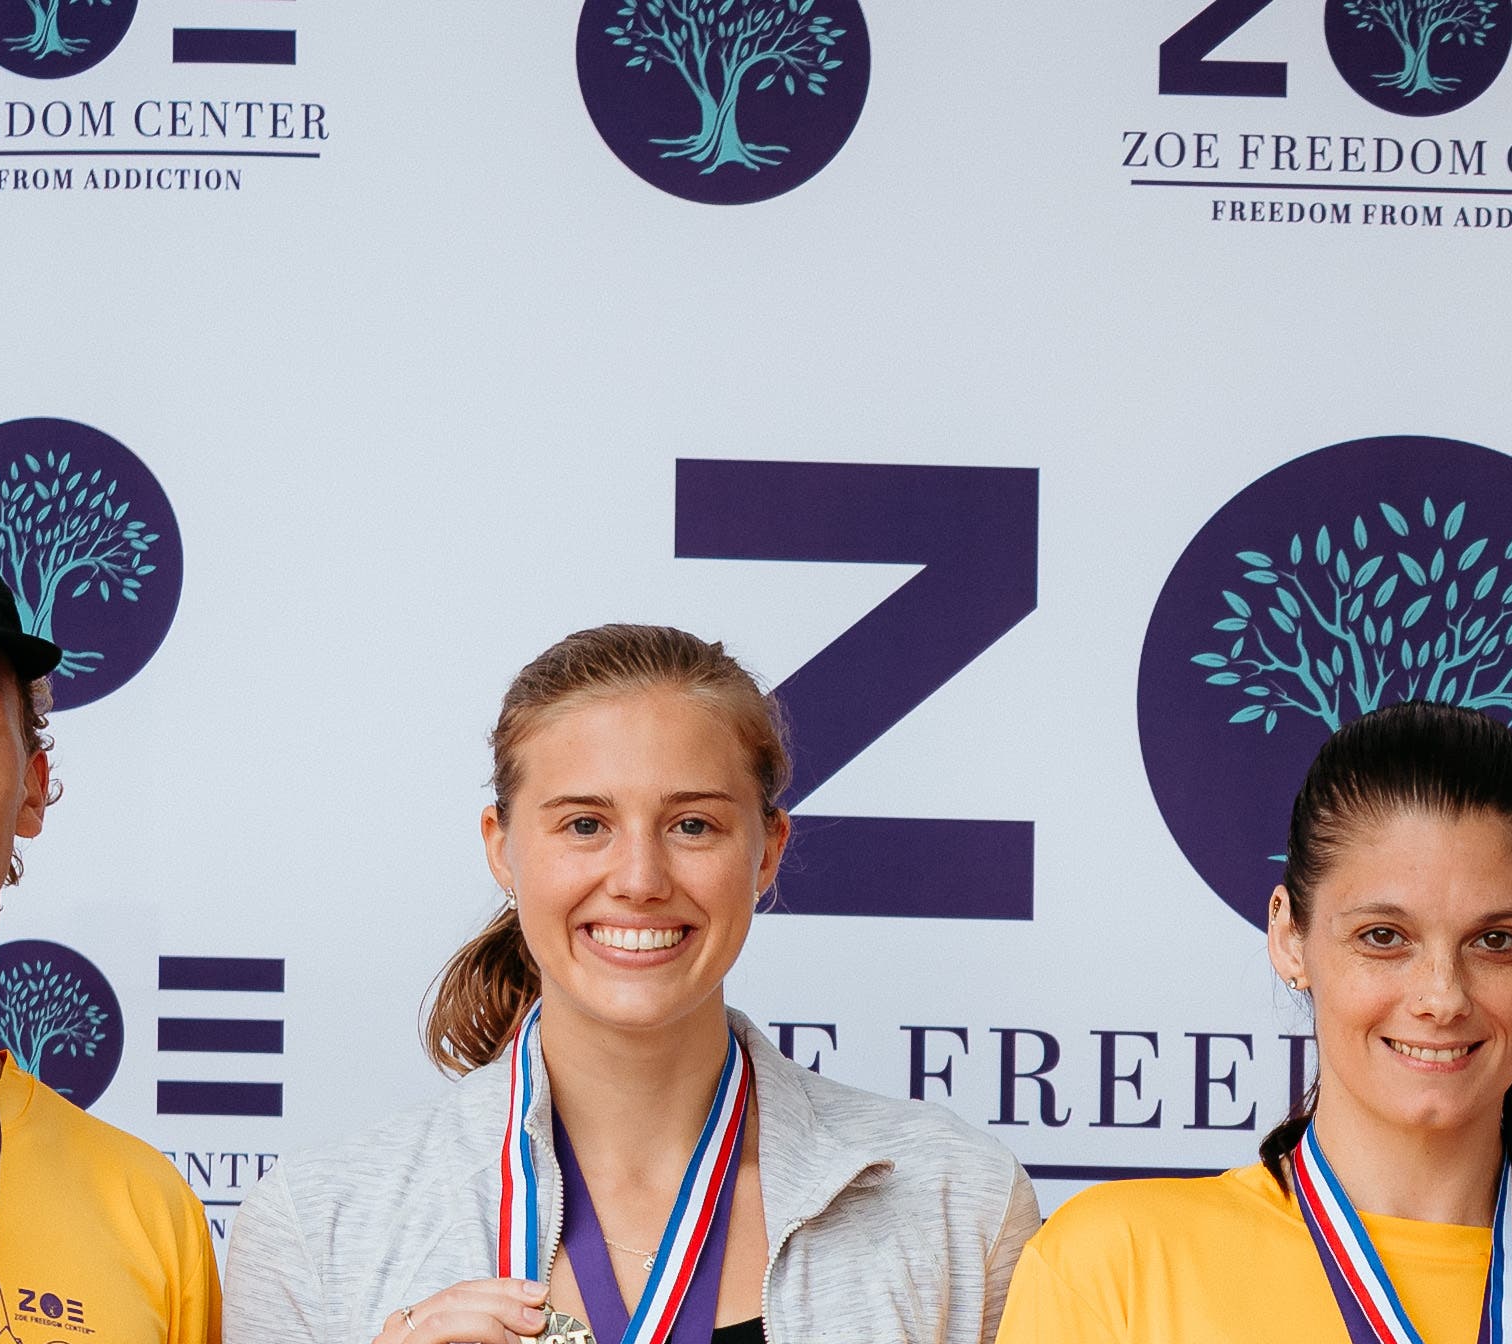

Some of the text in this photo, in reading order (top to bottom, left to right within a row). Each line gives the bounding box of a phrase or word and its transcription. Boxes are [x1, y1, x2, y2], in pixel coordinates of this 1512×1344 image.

[133, 99, 331, 141] CENTER
[1121, 130, 1221, 170] ZOE
[1238, 133, 1489, 177] FREEDOM
[82, 167, 241, 192] ADDICTION
[1210, 199, 1353, 225] FREEDOM
[1361, 202, 1444, 228] FROM
